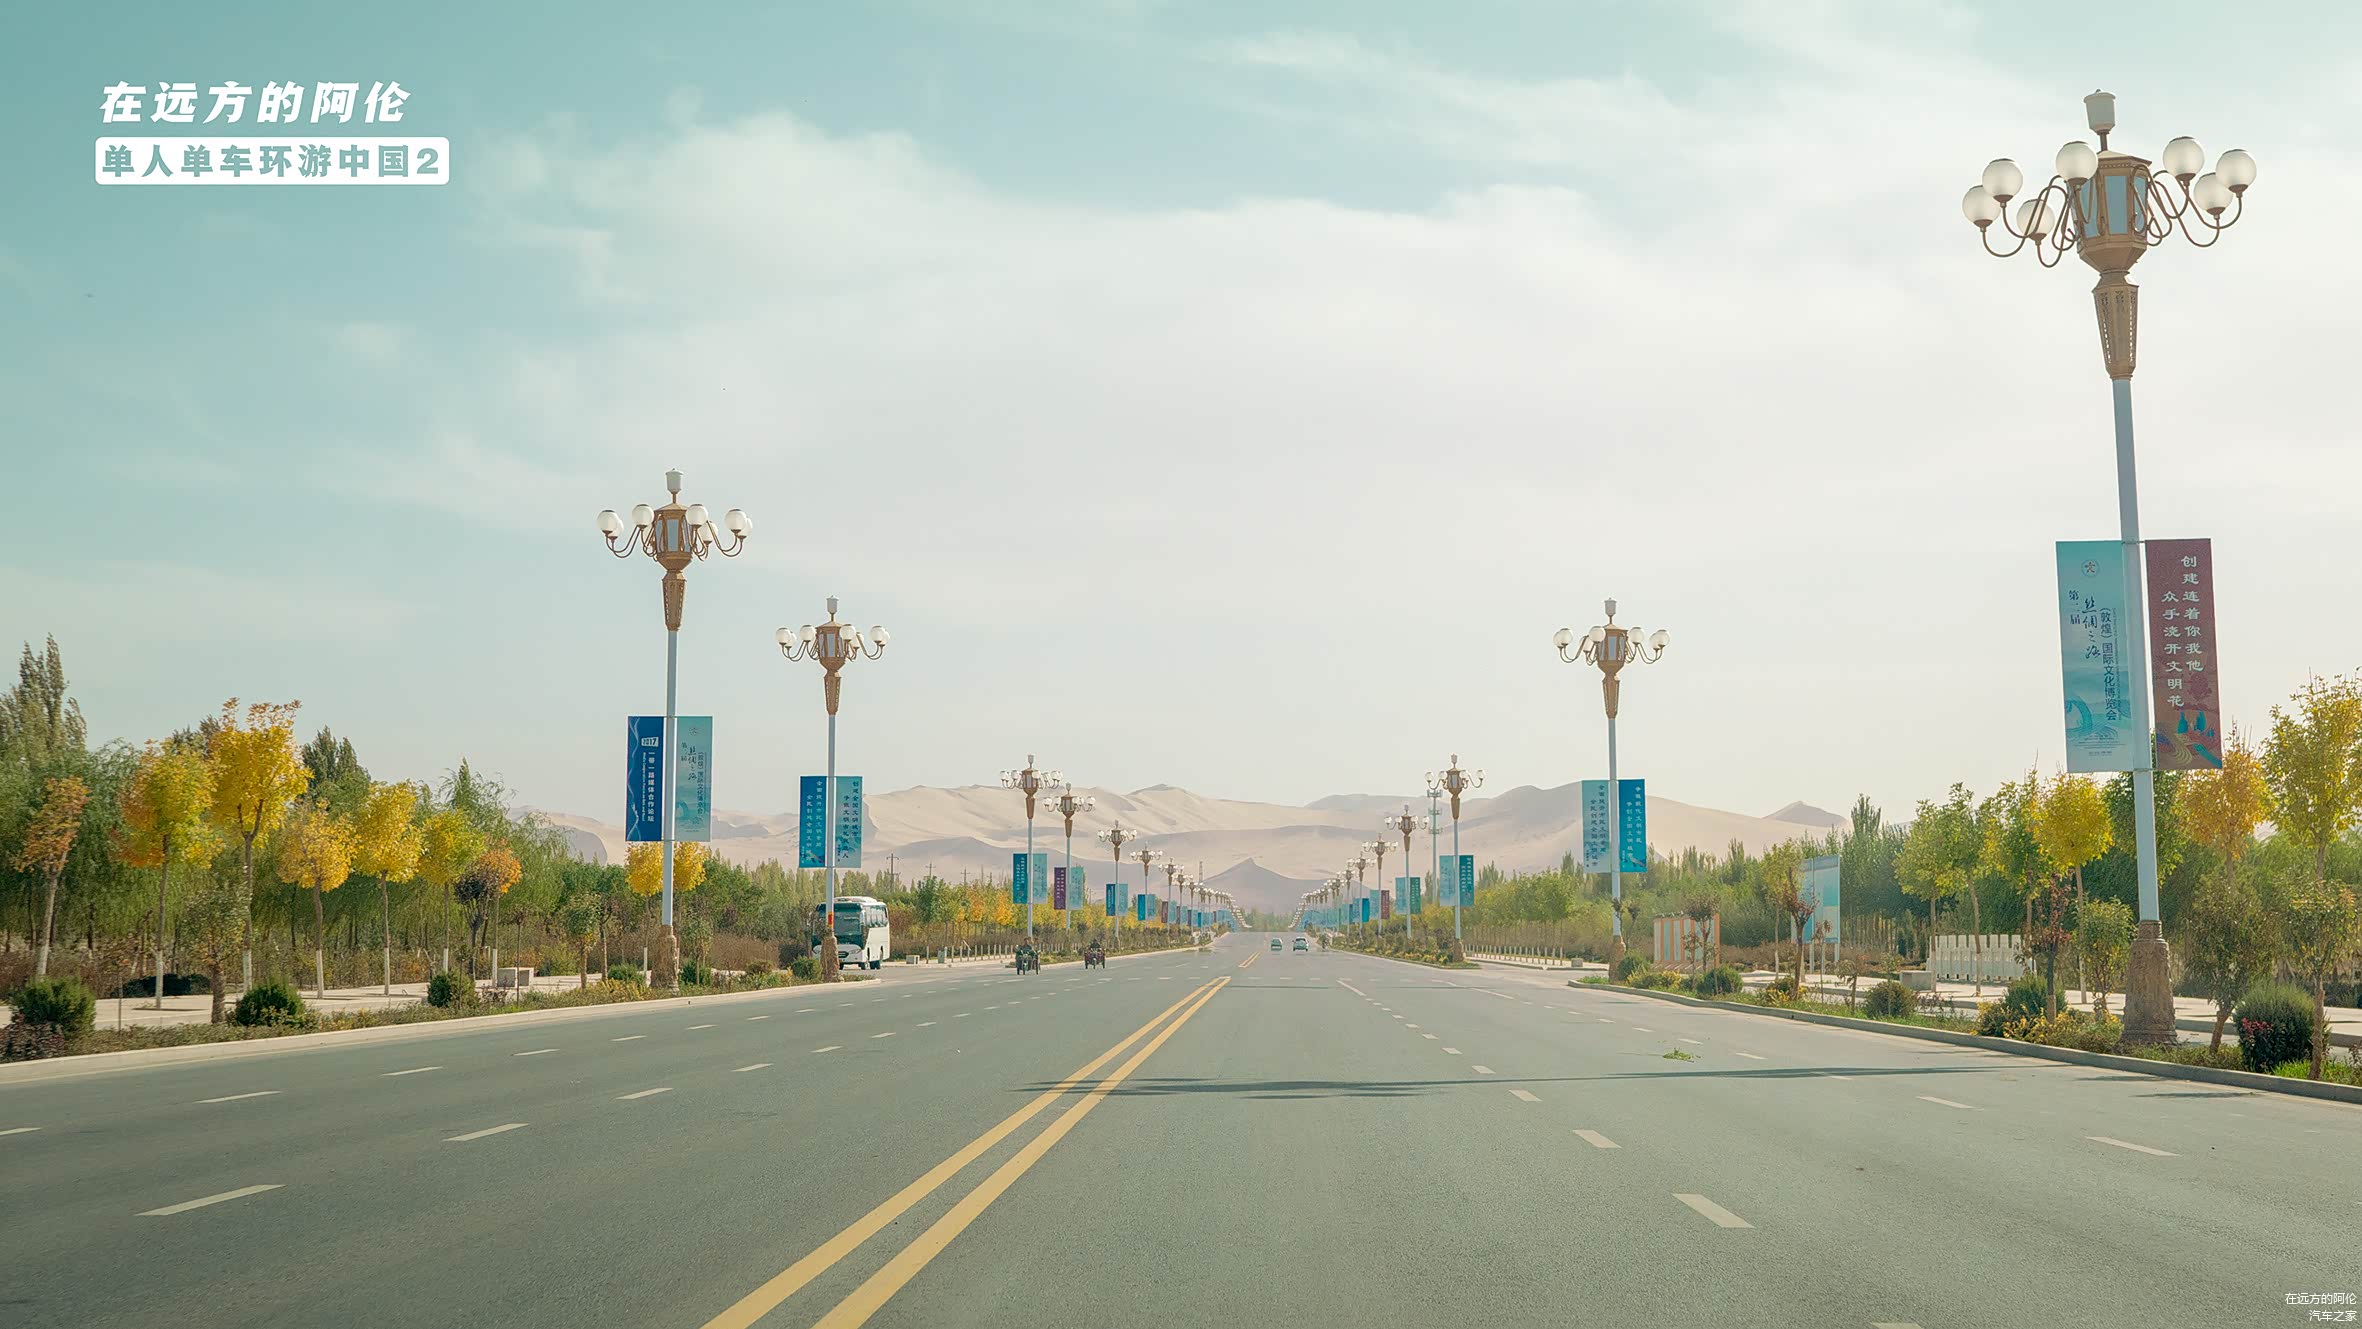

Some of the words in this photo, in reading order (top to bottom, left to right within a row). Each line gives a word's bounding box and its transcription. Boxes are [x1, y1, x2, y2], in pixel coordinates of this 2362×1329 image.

[2181, 555, 2204, 672] 创建连着你我他
